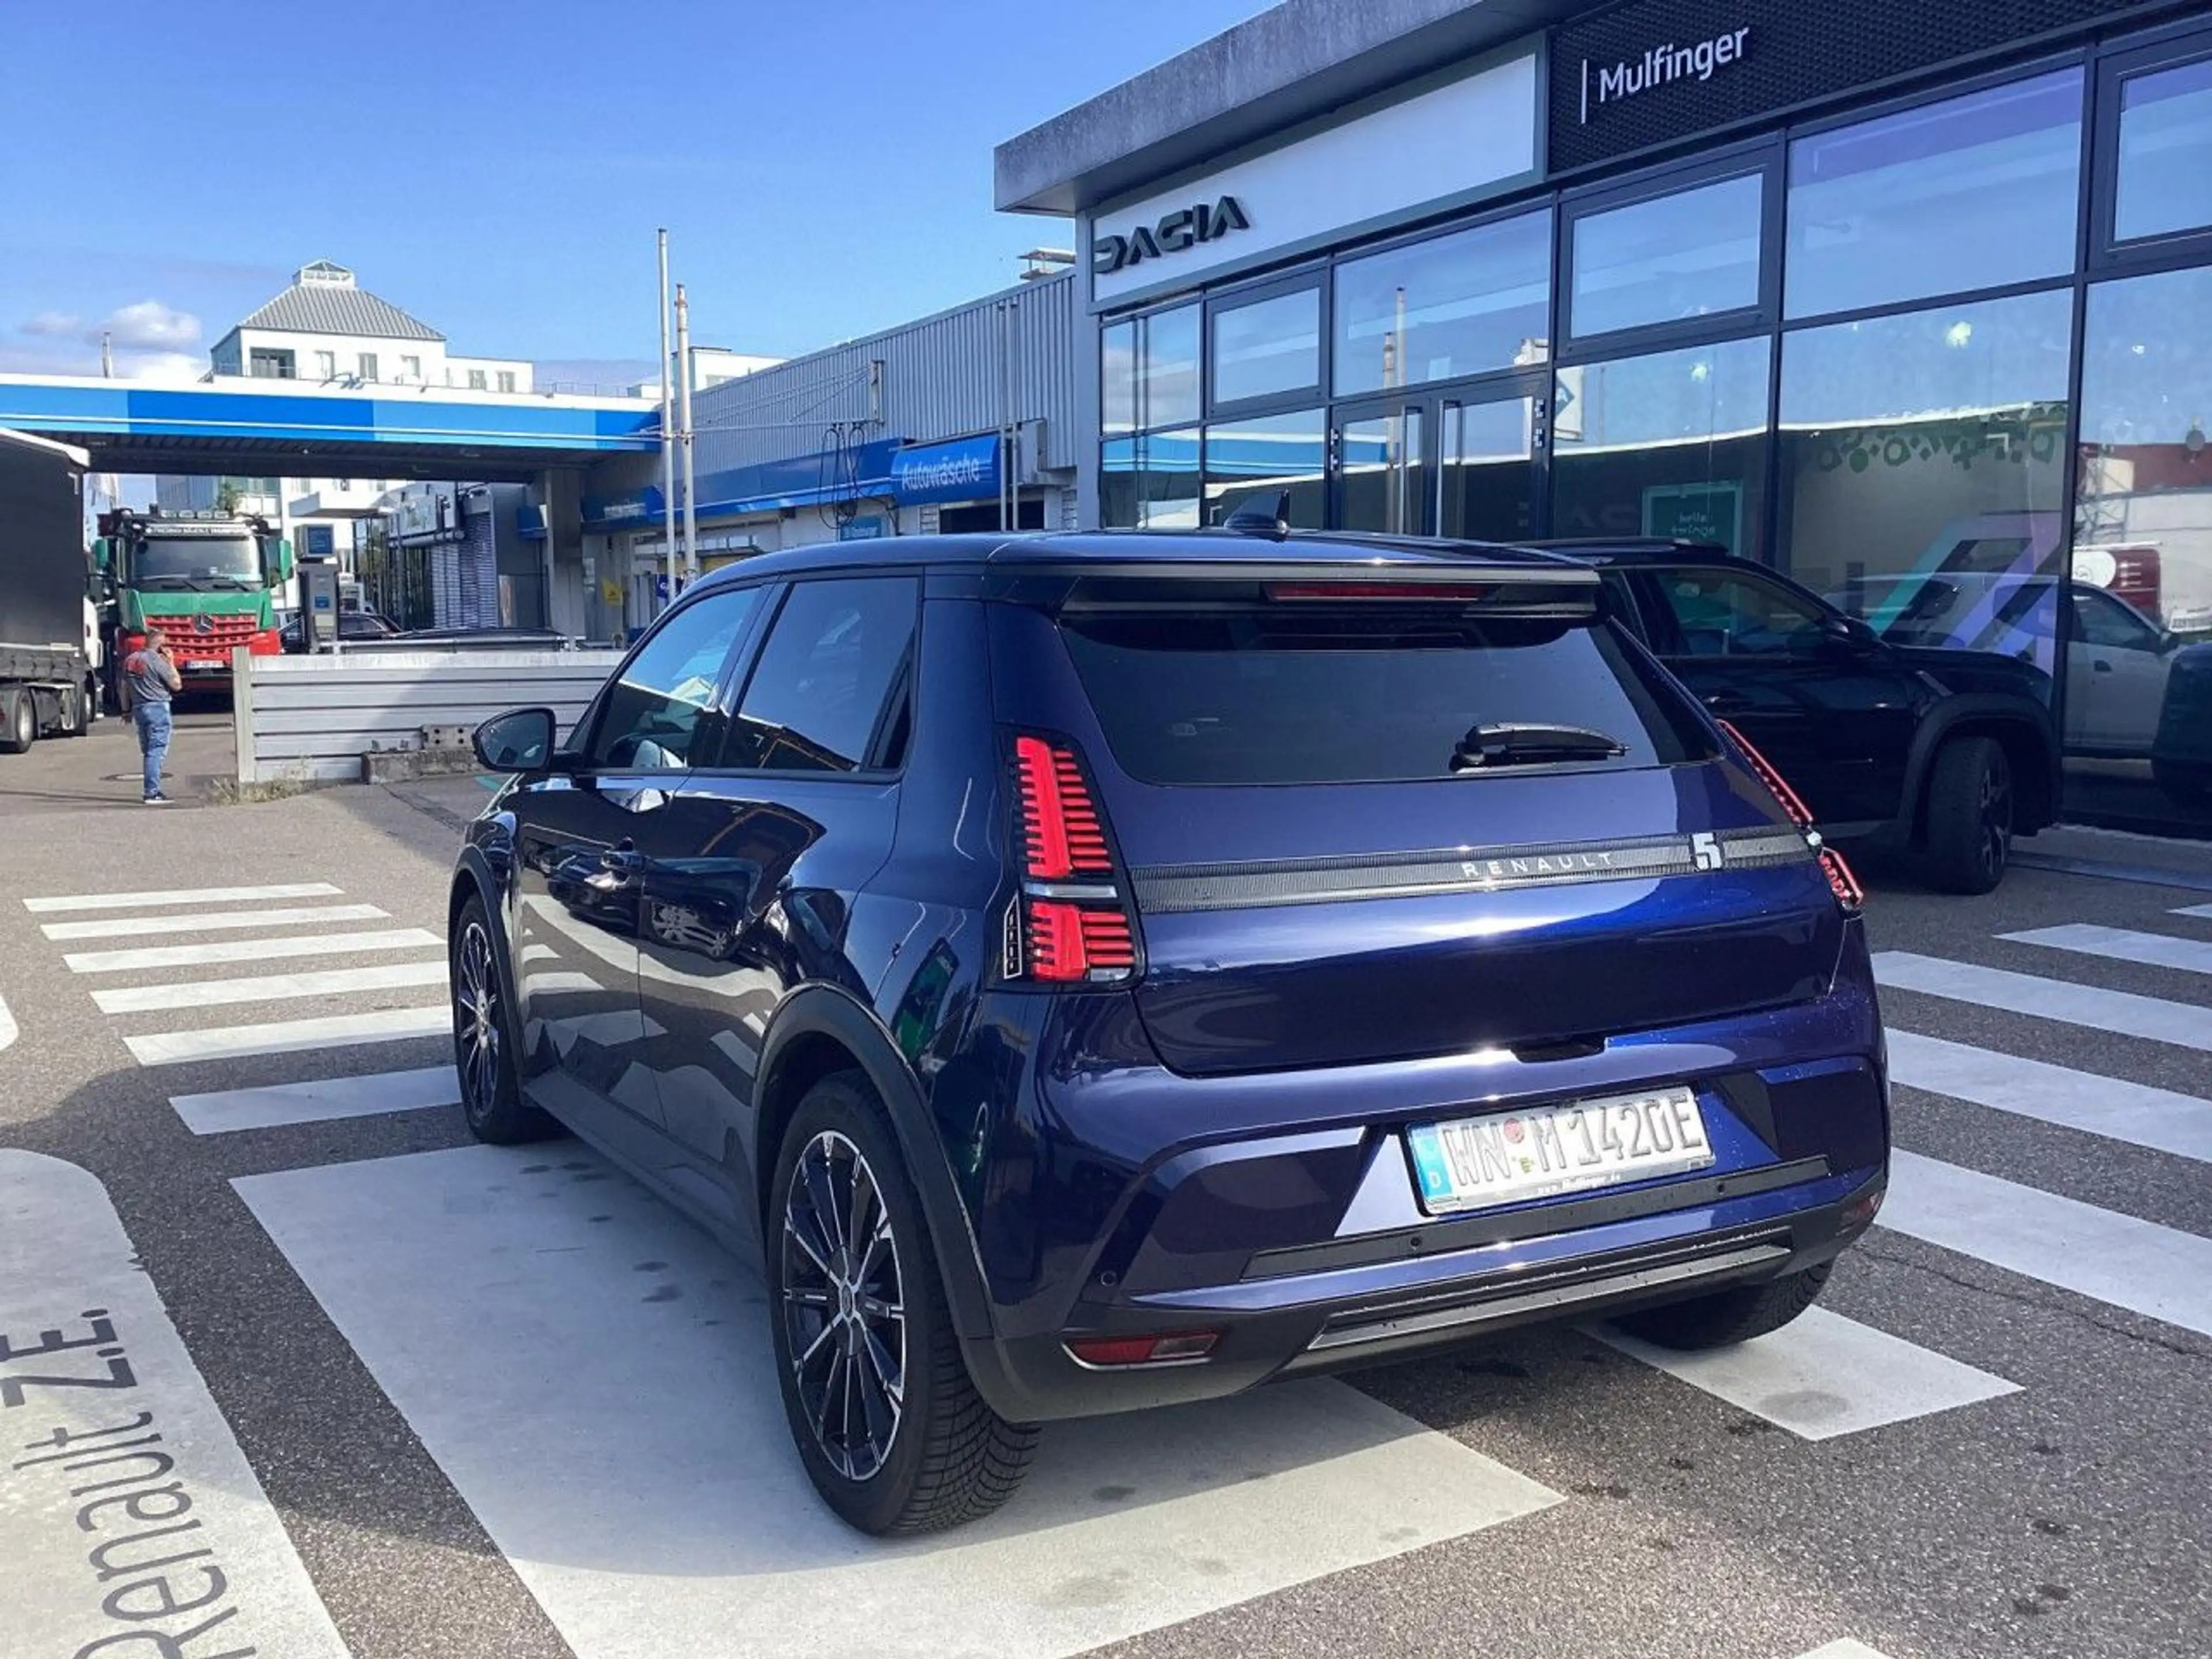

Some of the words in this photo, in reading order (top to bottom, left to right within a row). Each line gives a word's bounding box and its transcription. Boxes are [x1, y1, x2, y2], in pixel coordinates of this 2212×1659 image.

[1599, 26, 1750, 103] Mulfinger
[1094, 196, 1249, 273] DACIA
[902, 452, 980, 491] Autowäsche
[1461, 852, 1615, 877] RENAULT
[1692, 832, 1722, 871] 5
[1428, 1170, 1441, 1188] D
[1442, 1122, 1511, 1186] WN
[1528, 1113, 1567, 1172] M
[0, 1308, 138, 1407] Z.E.
[13, 1411, 256, 1659] Renault
